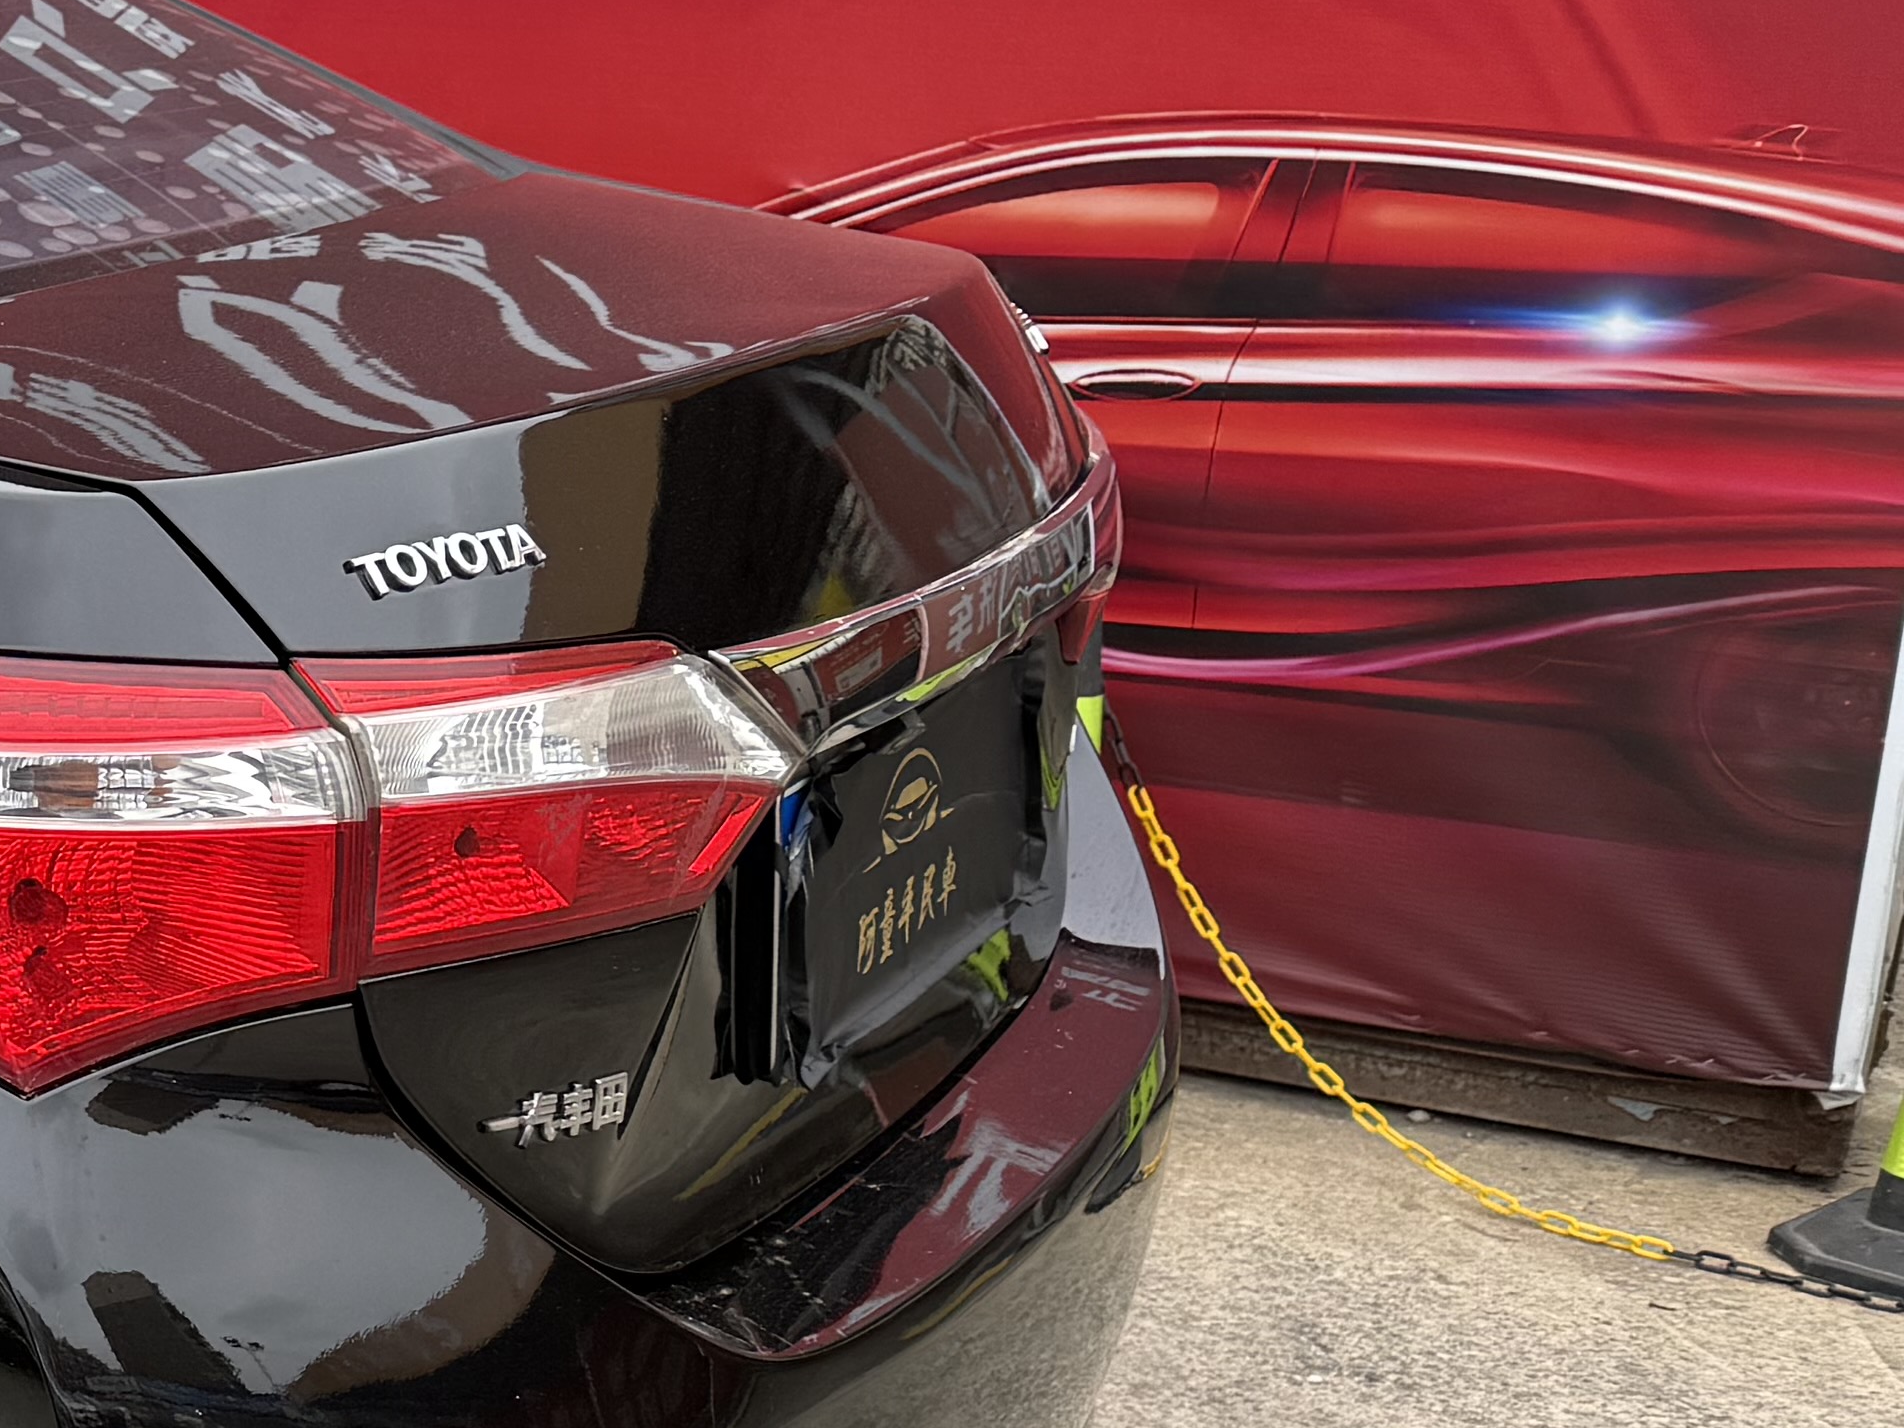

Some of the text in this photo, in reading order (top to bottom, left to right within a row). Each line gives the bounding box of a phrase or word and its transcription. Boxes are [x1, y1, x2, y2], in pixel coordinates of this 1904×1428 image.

[343, 523, 548, 601] TOYOTA
[478, 1072, 629, 1149] 一汽丰田
